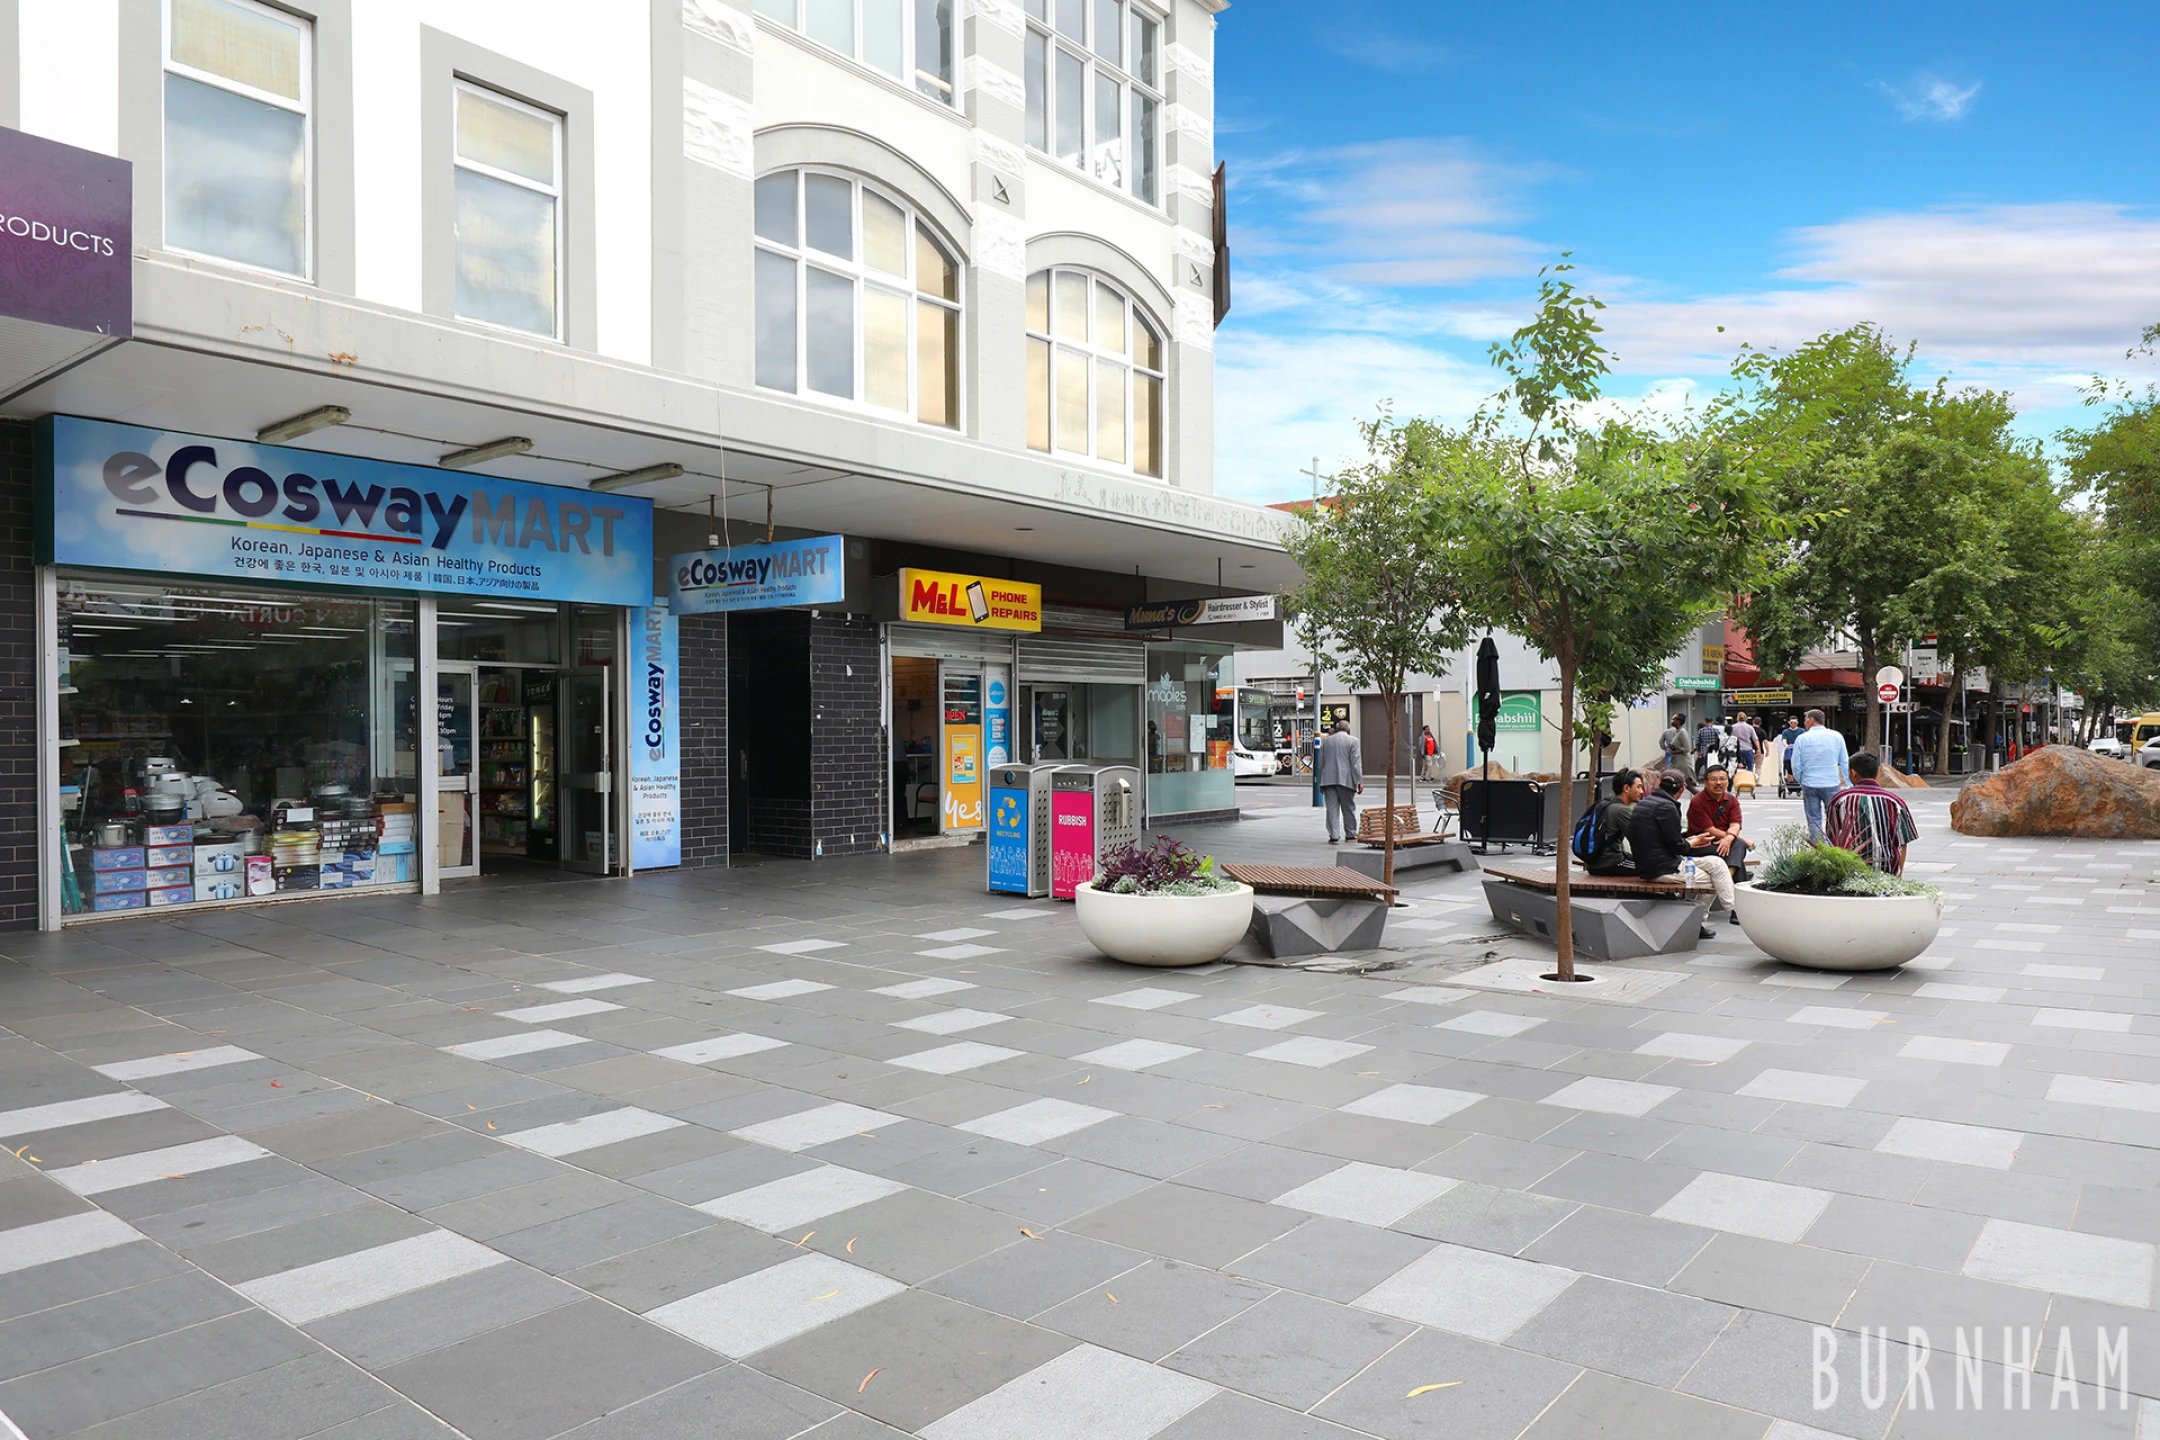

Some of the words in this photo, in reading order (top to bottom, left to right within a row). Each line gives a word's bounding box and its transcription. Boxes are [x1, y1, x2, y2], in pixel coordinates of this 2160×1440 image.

[298, 542, 369, 561] Japanese
[374, 549, 385, 564] &
[392, 551, 430, 567] Asian
[437, 556, 484, 575] Healthy
[488, 560, 542, 577] Products
[234, 556, 269, 570] 건강에
[274, 559, 296, 572] 좋은
[329, 564, 350, 577] 일본
[369, 567, 399, 581] 아시아
[403, 570, 423, 582] 제품
[991, 590, 1028, 604] PHONE
[1208, 602, 1242, 612] Hairdresser
[1249, 599, 1268, 611] Stylist
[991, 607, 1037, 621] REPAIRS
[1147, 686, 1187, 706] maples
[1475, 712, 1536, 724] Dabshiil
[656, 783, 676, 791] Healthy
[1058, 814, 1087, 827] RUBBISH
[996, 830, 1021, 838] RECYCLING
